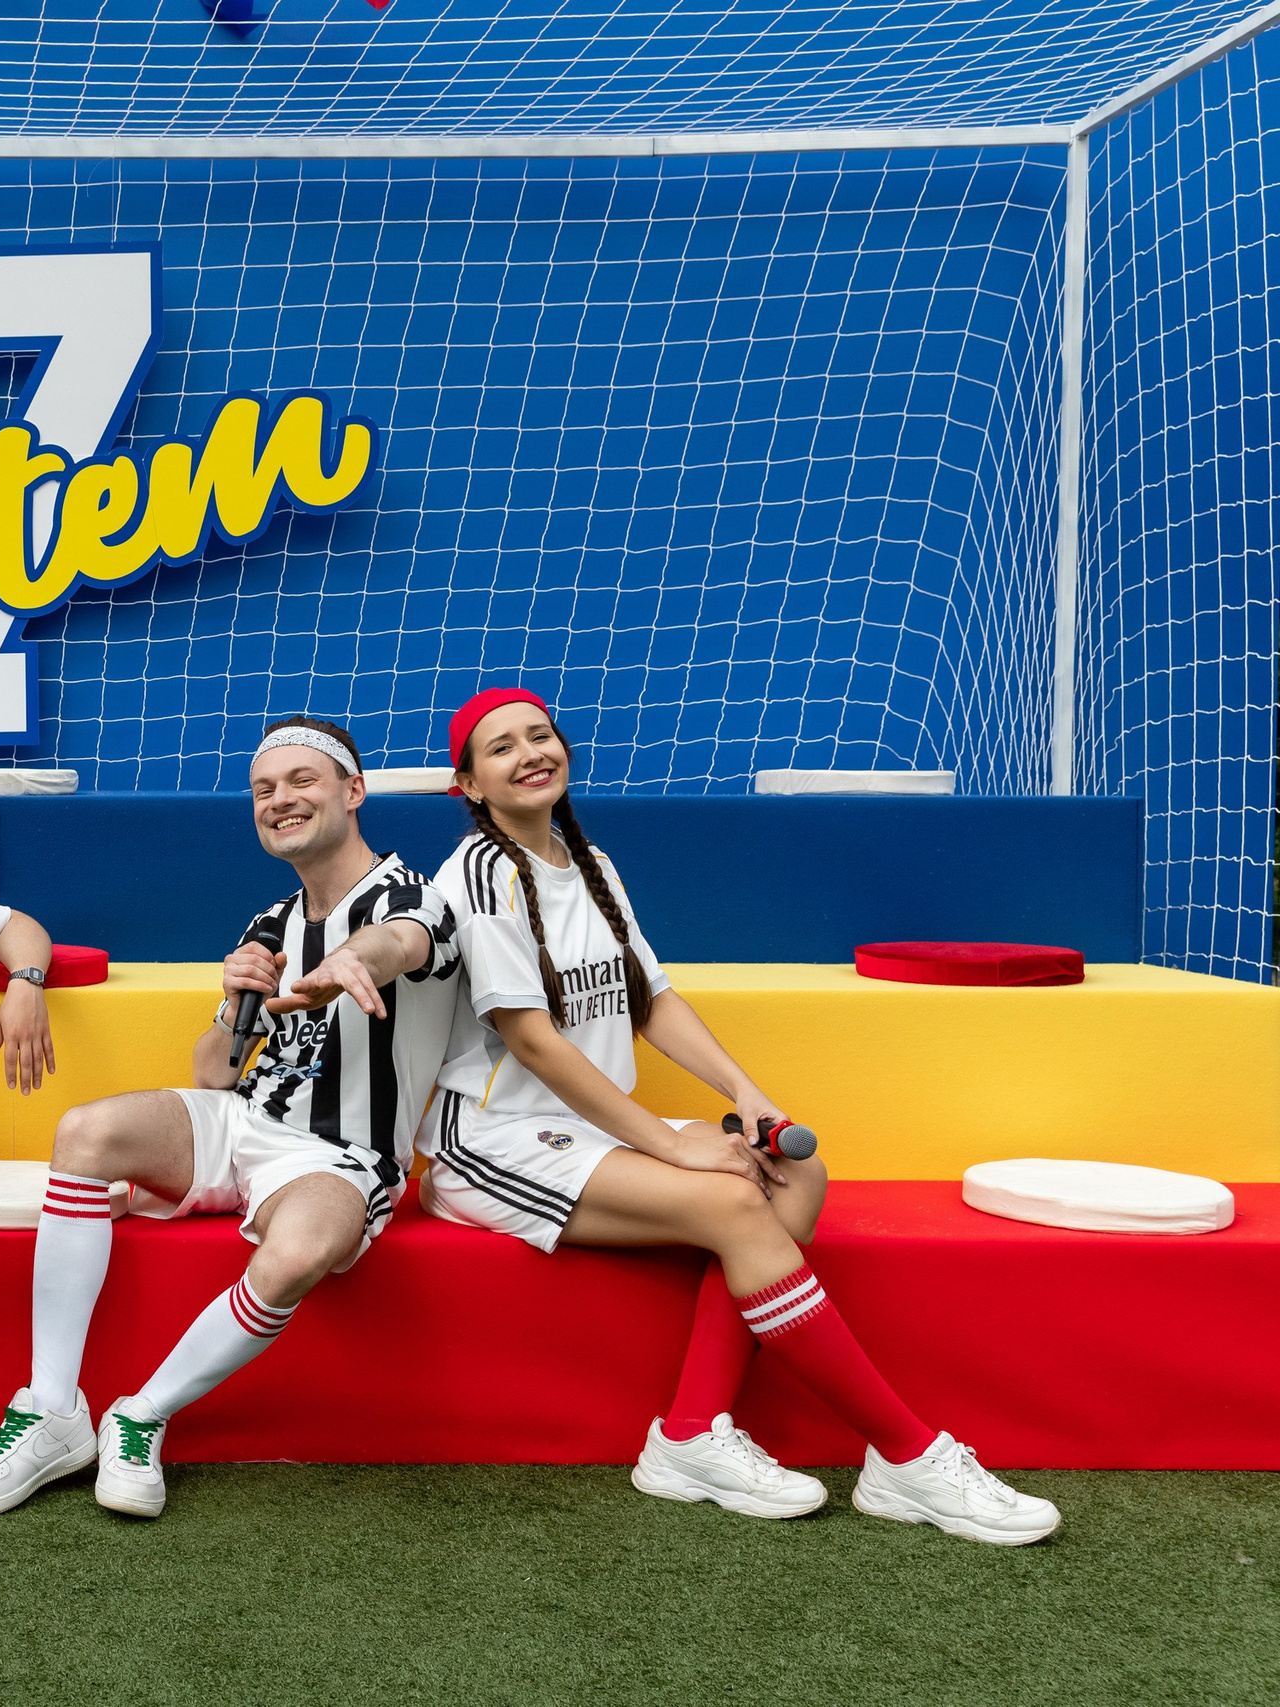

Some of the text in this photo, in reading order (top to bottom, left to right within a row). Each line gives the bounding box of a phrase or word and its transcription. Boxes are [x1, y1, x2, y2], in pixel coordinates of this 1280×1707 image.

[556, 953, 623, 996] mirat
[585, 989, 630, 1022] BETTE
[276, 1012, 329, 1049] Jee
